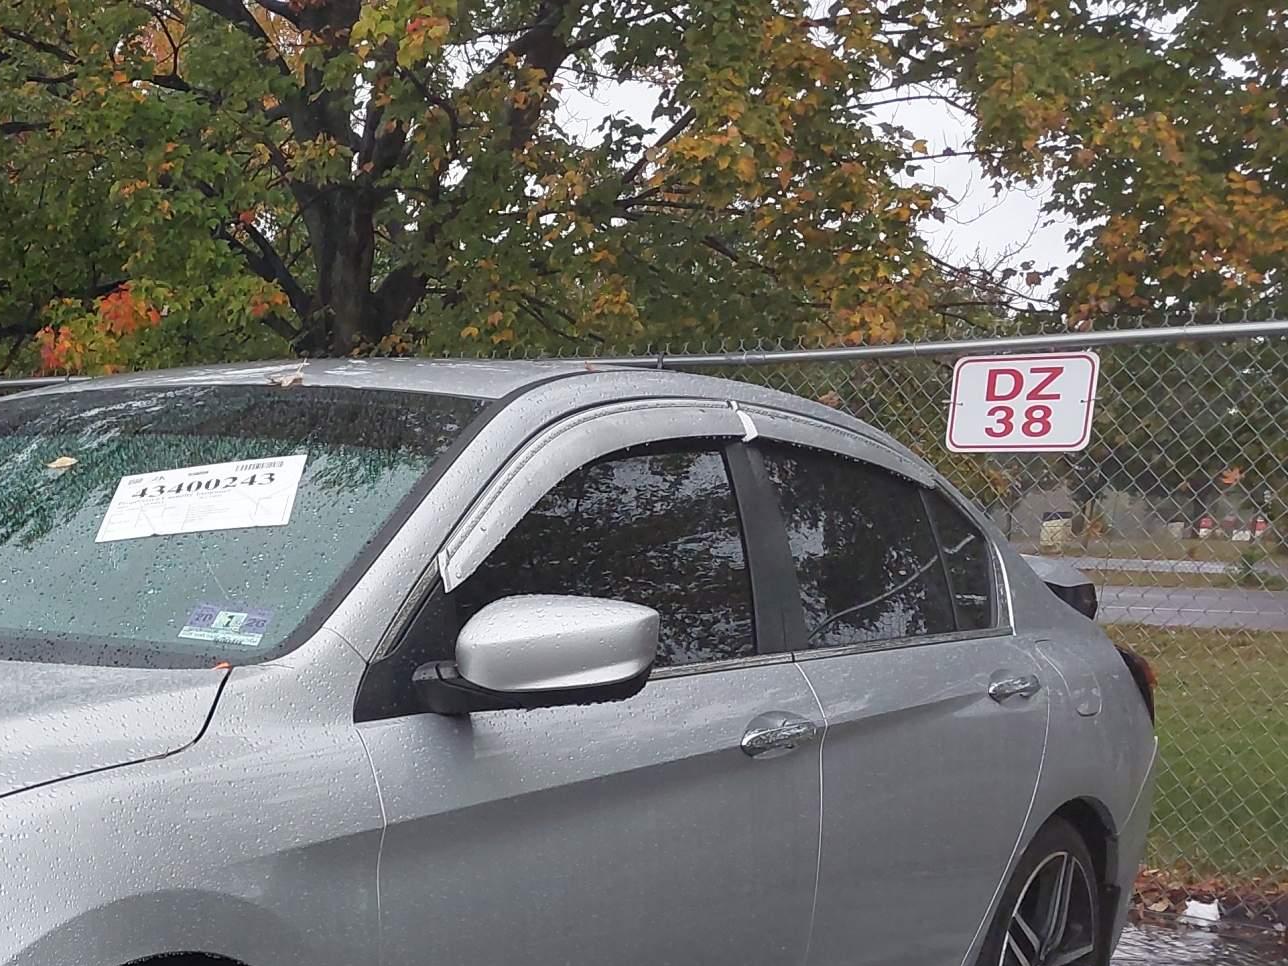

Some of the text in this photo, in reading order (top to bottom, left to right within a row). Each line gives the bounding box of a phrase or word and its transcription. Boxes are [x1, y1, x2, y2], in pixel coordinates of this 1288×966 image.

[985, 366, 1065, 401] DZ
[984, 405, 1053, 438] 38
[131, 472, 276, 499] 43400243
